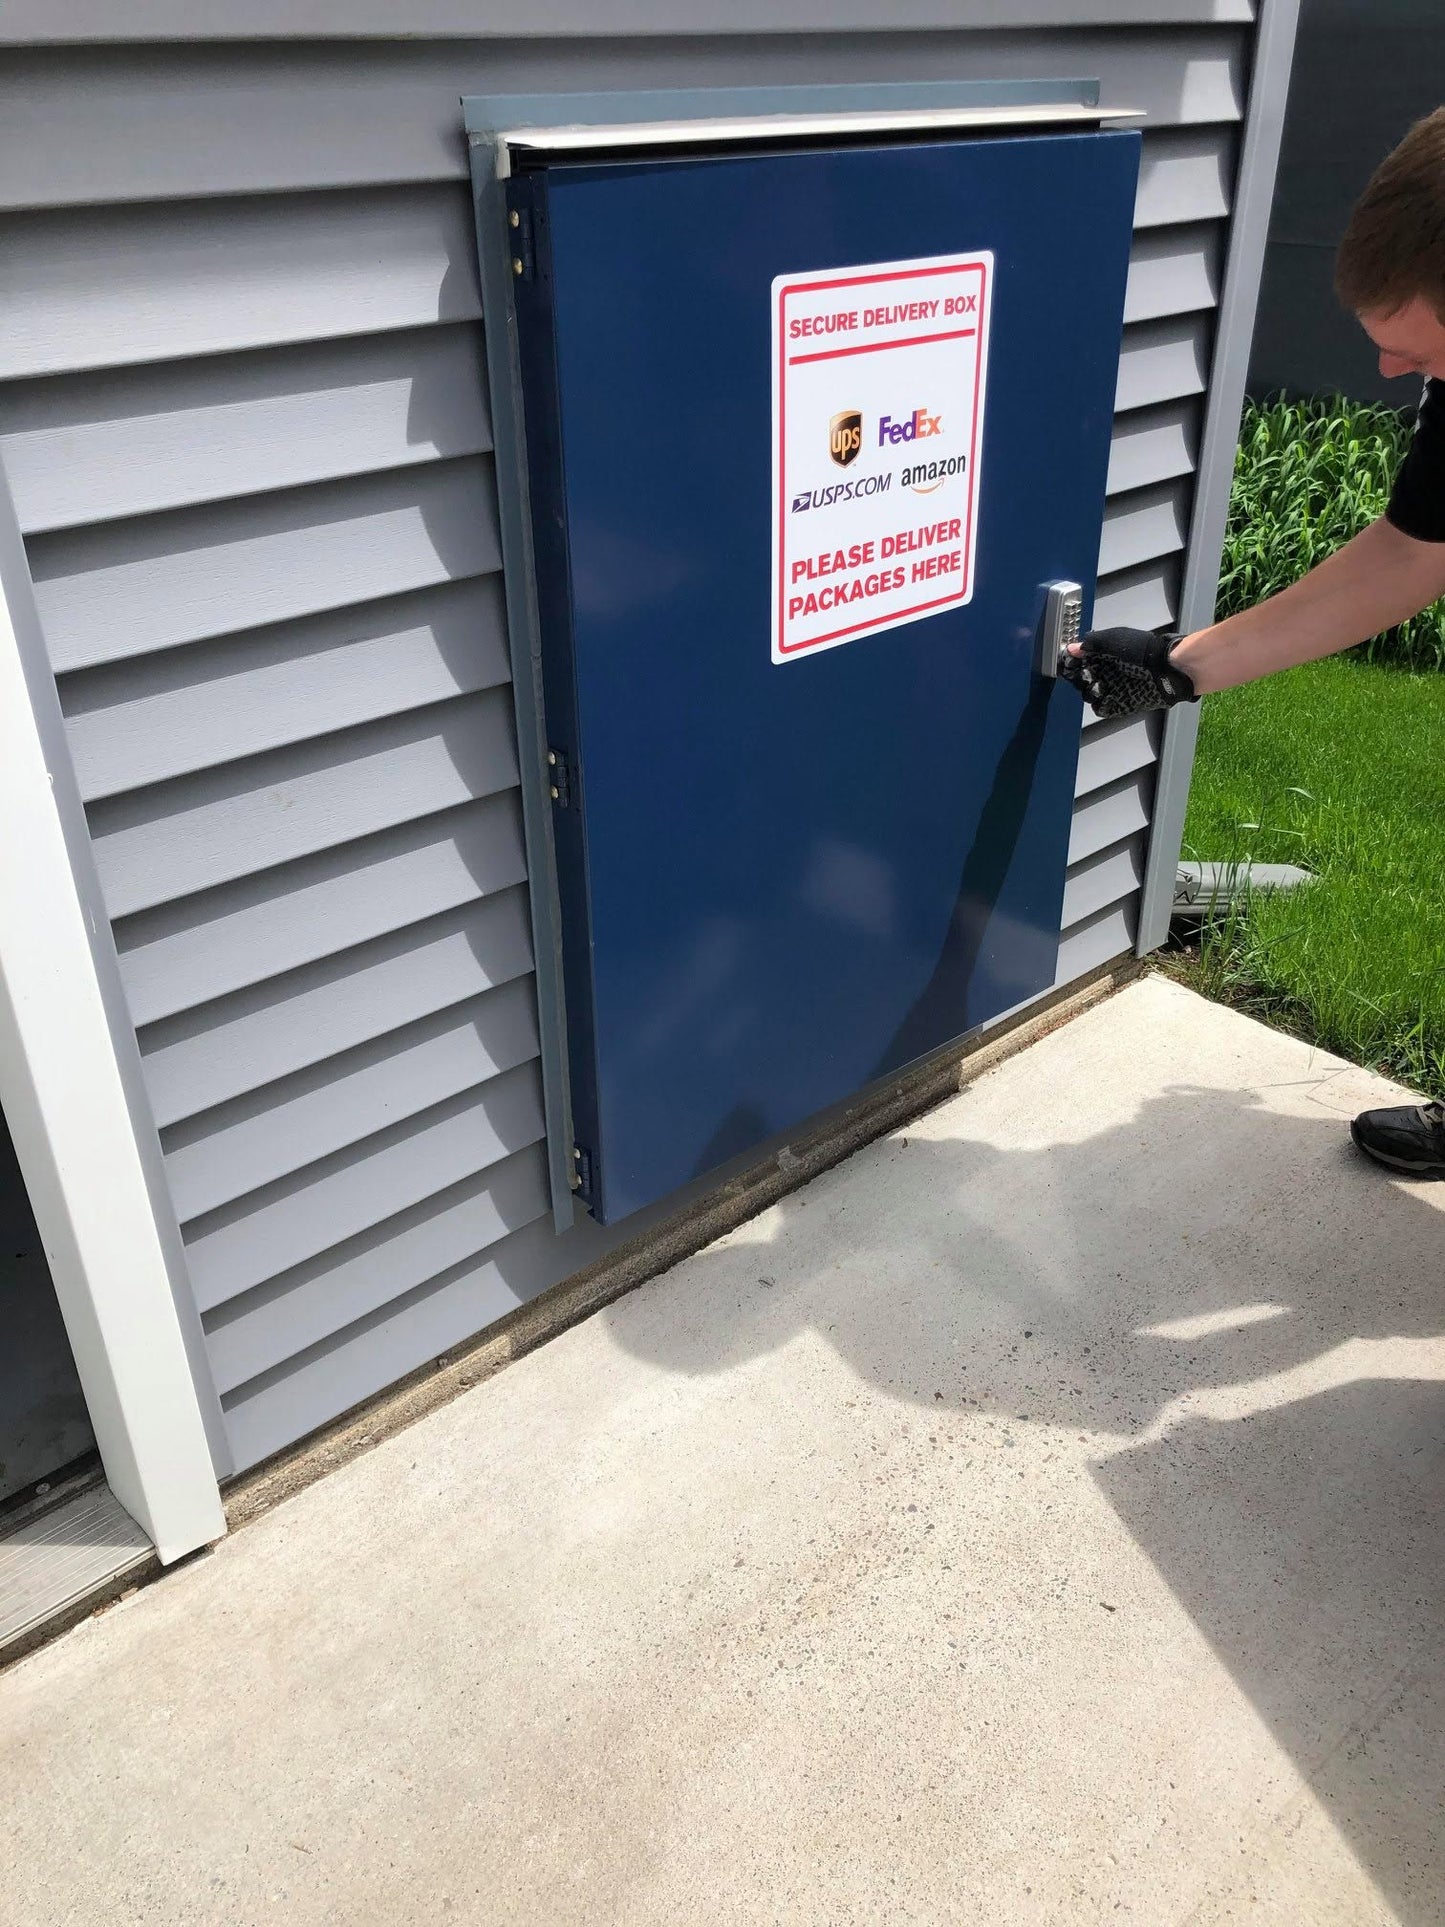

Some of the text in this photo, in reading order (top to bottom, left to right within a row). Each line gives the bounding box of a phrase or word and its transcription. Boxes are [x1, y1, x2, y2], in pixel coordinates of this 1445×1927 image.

[790, 295, 977, 339] SECURE DELIVERY BOX
[832, 427, 860, 460] ups
[879, 408, 942, 447] FedEx
[812, 472, 892, 508] USPS.COM
[901, 455, 966, 487] amazon
[792, 518, 961, 584] PLEASE DELIVER
[789, 550, 961, 620] PACKAGES HERE
